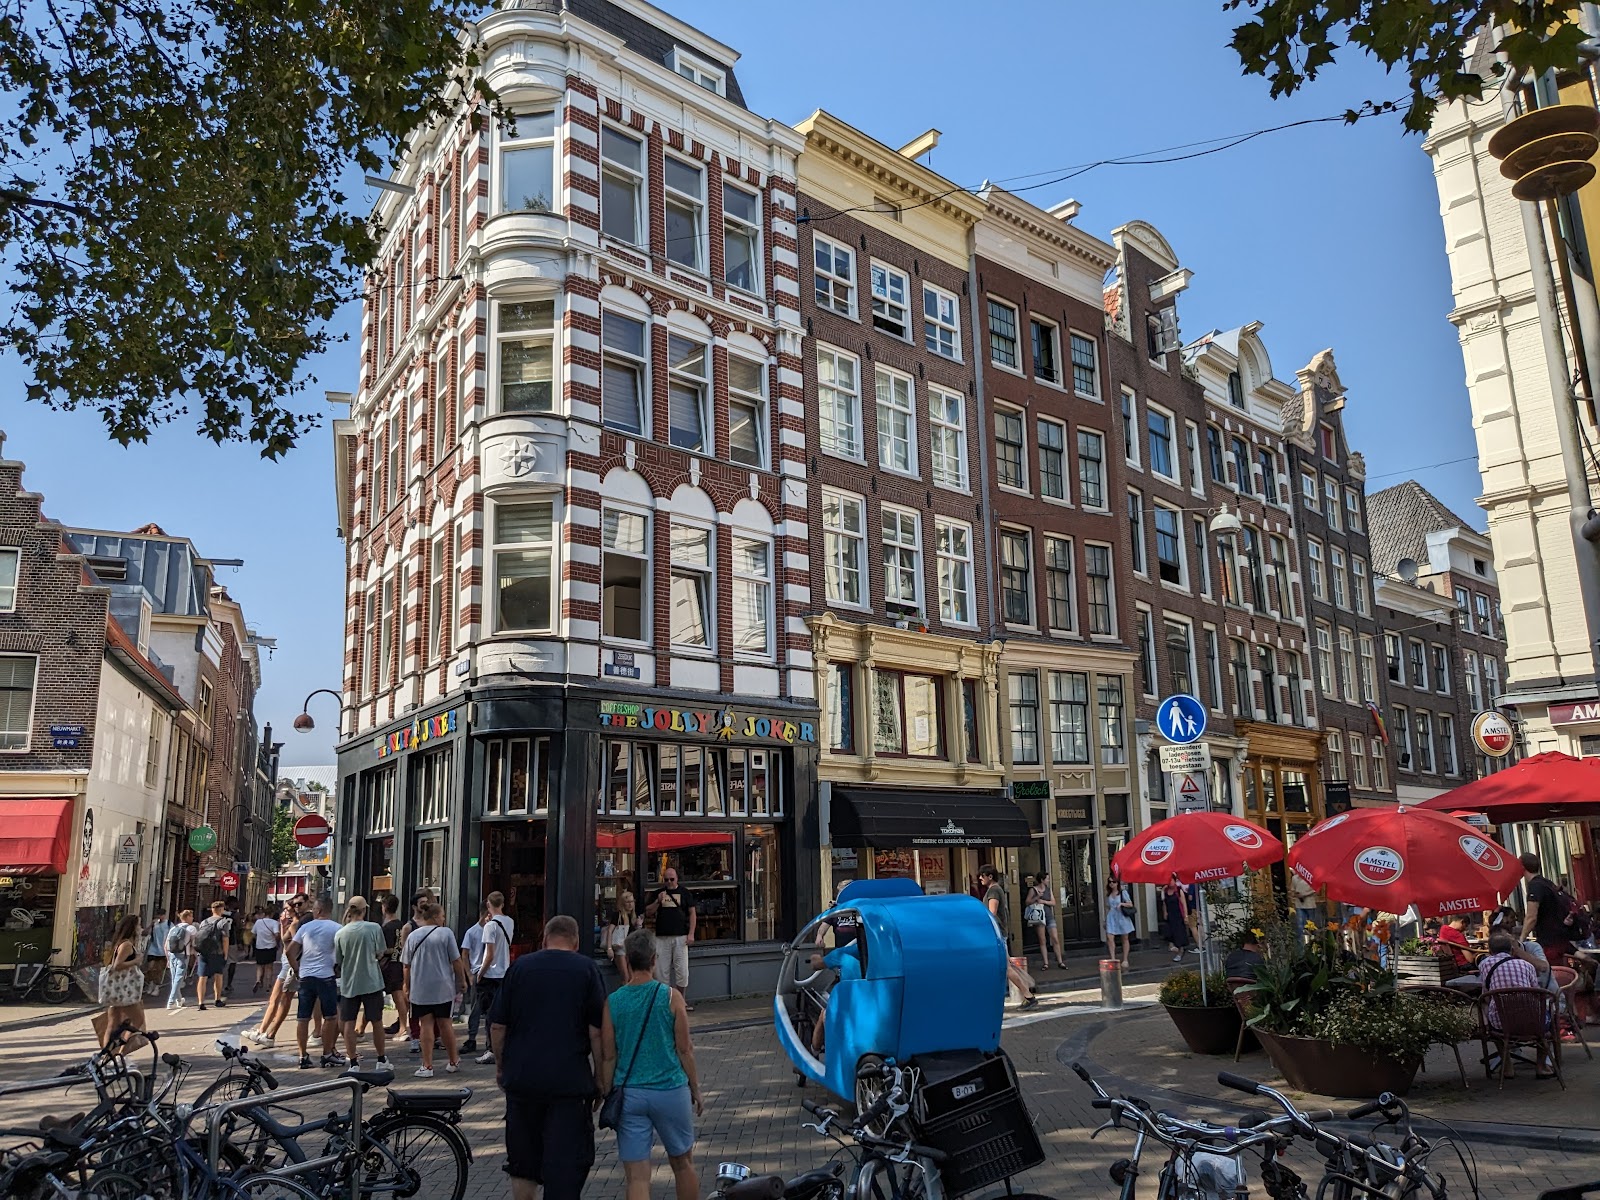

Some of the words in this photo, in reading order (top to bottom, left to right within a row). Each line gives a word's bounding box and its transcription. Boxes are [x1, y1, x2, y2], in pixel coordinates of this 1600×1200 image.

[617, 653, 633, 661] ZEEDIJK
[601, 702, 640, 715] COFFEESHOP
[421, 710, 456, 741] JOKER
[600, 714, 638, 728] THE
[640, 708, 711, 733] JOLLY
[744, 717, 814, 744] JOKER
[1484, 727, 1509, 735] AMSTEL
[1165, 744, 1201, 752] uitgezonderd
[1014, 782, 1048, 798] Grolsch
[1233, 830, 1250, 839] AMSTEL
[1472, 843, 1486, 859] AMSTEL
[1363, 857, 1396, 869] AMSTEL
[1194, 867, 1229, 880] AMSTEL
[1295, 861, 1313, 885] AMSTEL
[1369, 866, 1385, 874] BIER
[1439, 897, 1481, 912] AMSTEL
